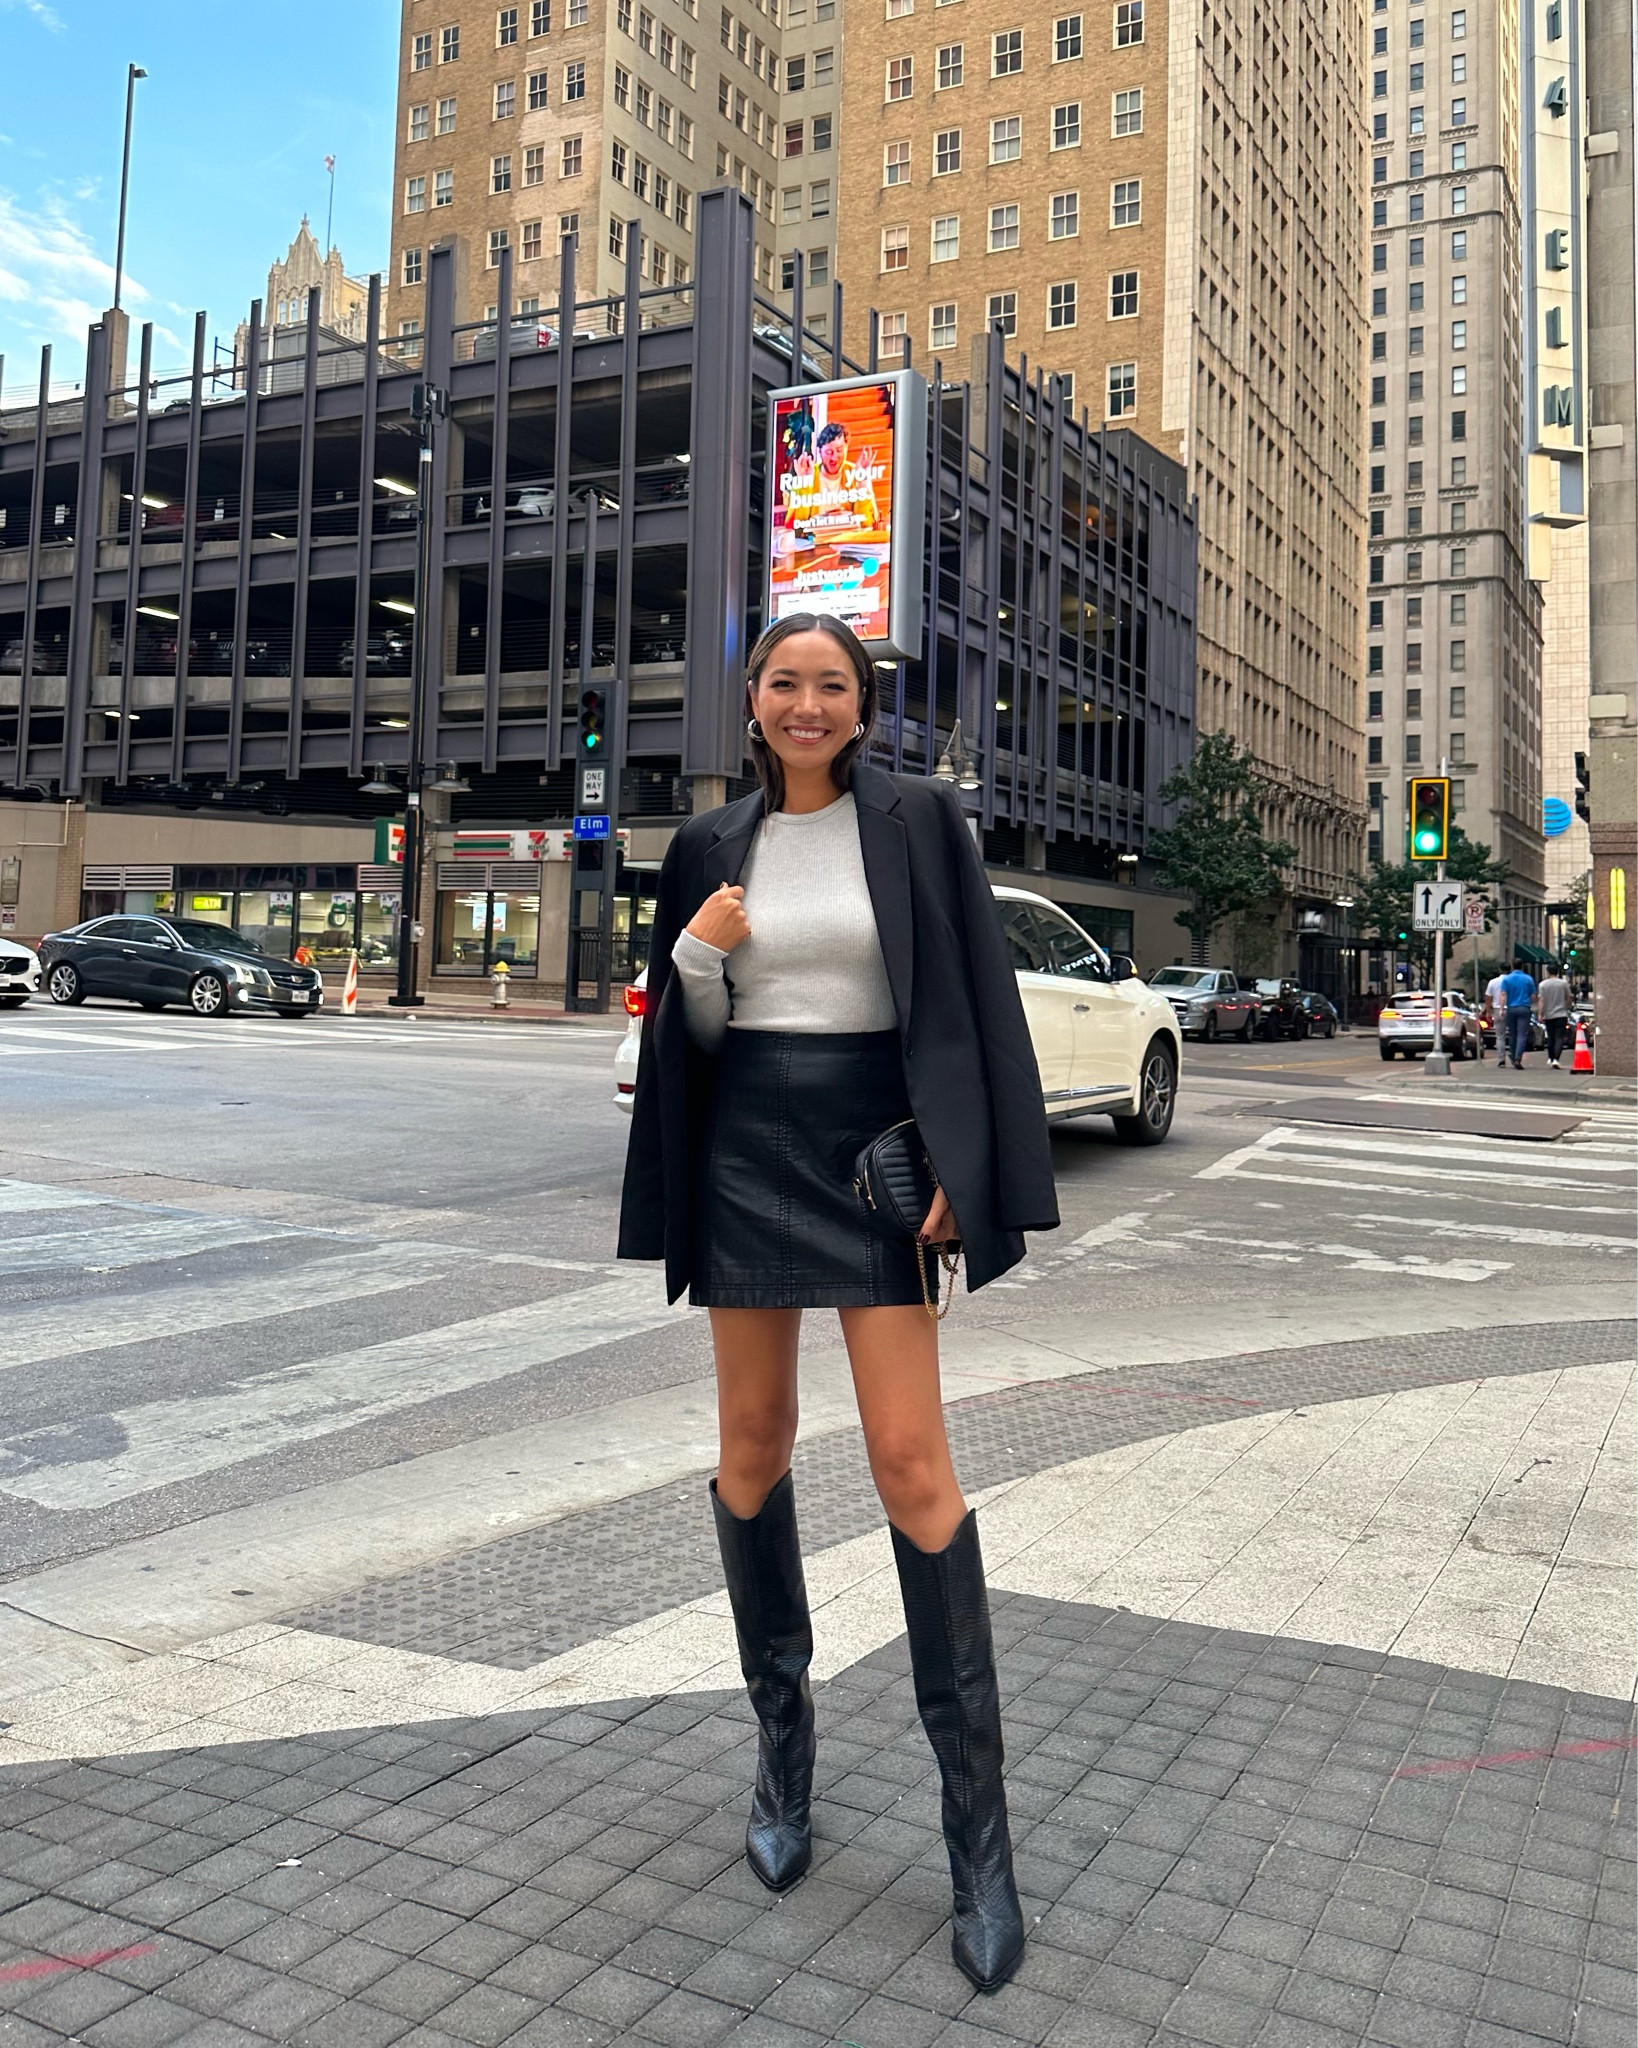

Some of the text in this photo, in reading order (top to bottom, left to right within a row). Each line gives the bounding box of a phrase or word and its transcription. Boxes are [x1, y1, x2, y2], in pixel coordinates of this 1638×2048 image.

[1545, 228, 1574, 427] ELM
[780, 465, 886, 491] Run your
[790, 487, 873, 509] business.
[586, 772, 602, 781] ONE
[586, 782, 602, 790] WAY
[580, 818, 603, 829] Elm
[529, 831, 546, 859] 7
[203, 898, 221, 909] ATM
[1415, 919, 1436, 927] ONLY
[1438, 919, 1460, 927] ONLY
